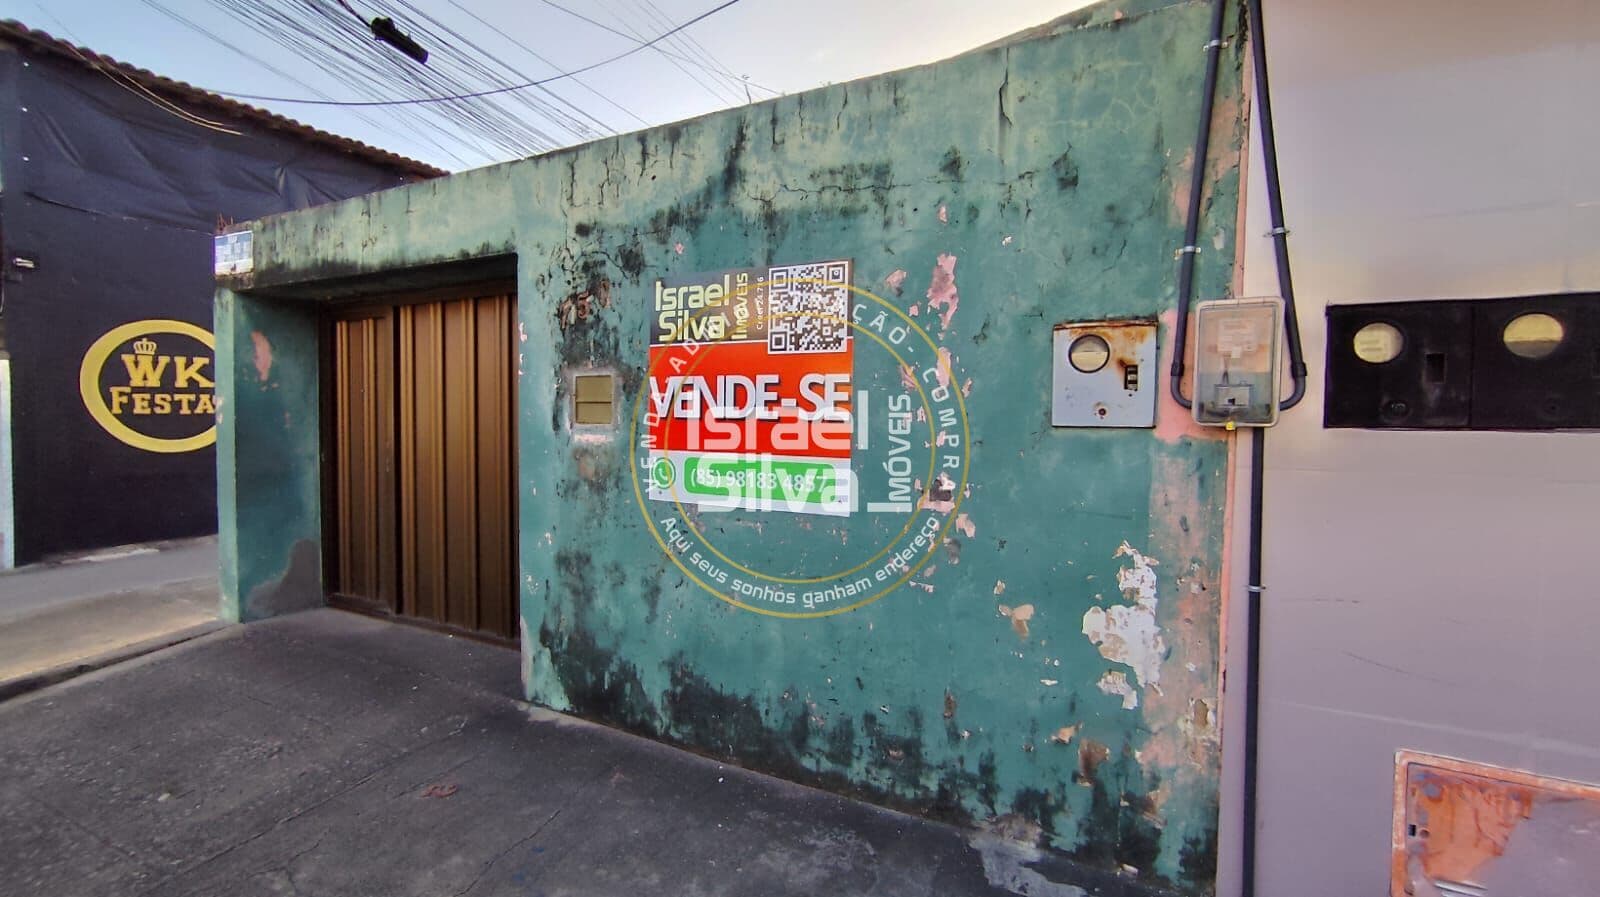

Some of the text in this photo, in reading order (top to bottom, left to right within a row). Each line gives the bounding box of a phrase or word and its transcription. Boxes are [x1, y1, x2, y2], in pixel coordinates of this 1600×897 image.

[655, 274, 730, 312] Israel
[658, 309, 725, 342] Silva
[121, 353, 216, 389] WK
[109, 386, 217, 415] FESTA
[649, 373, 850, 421] VENDE-SE
[690, 468, 720, 488] (85)
